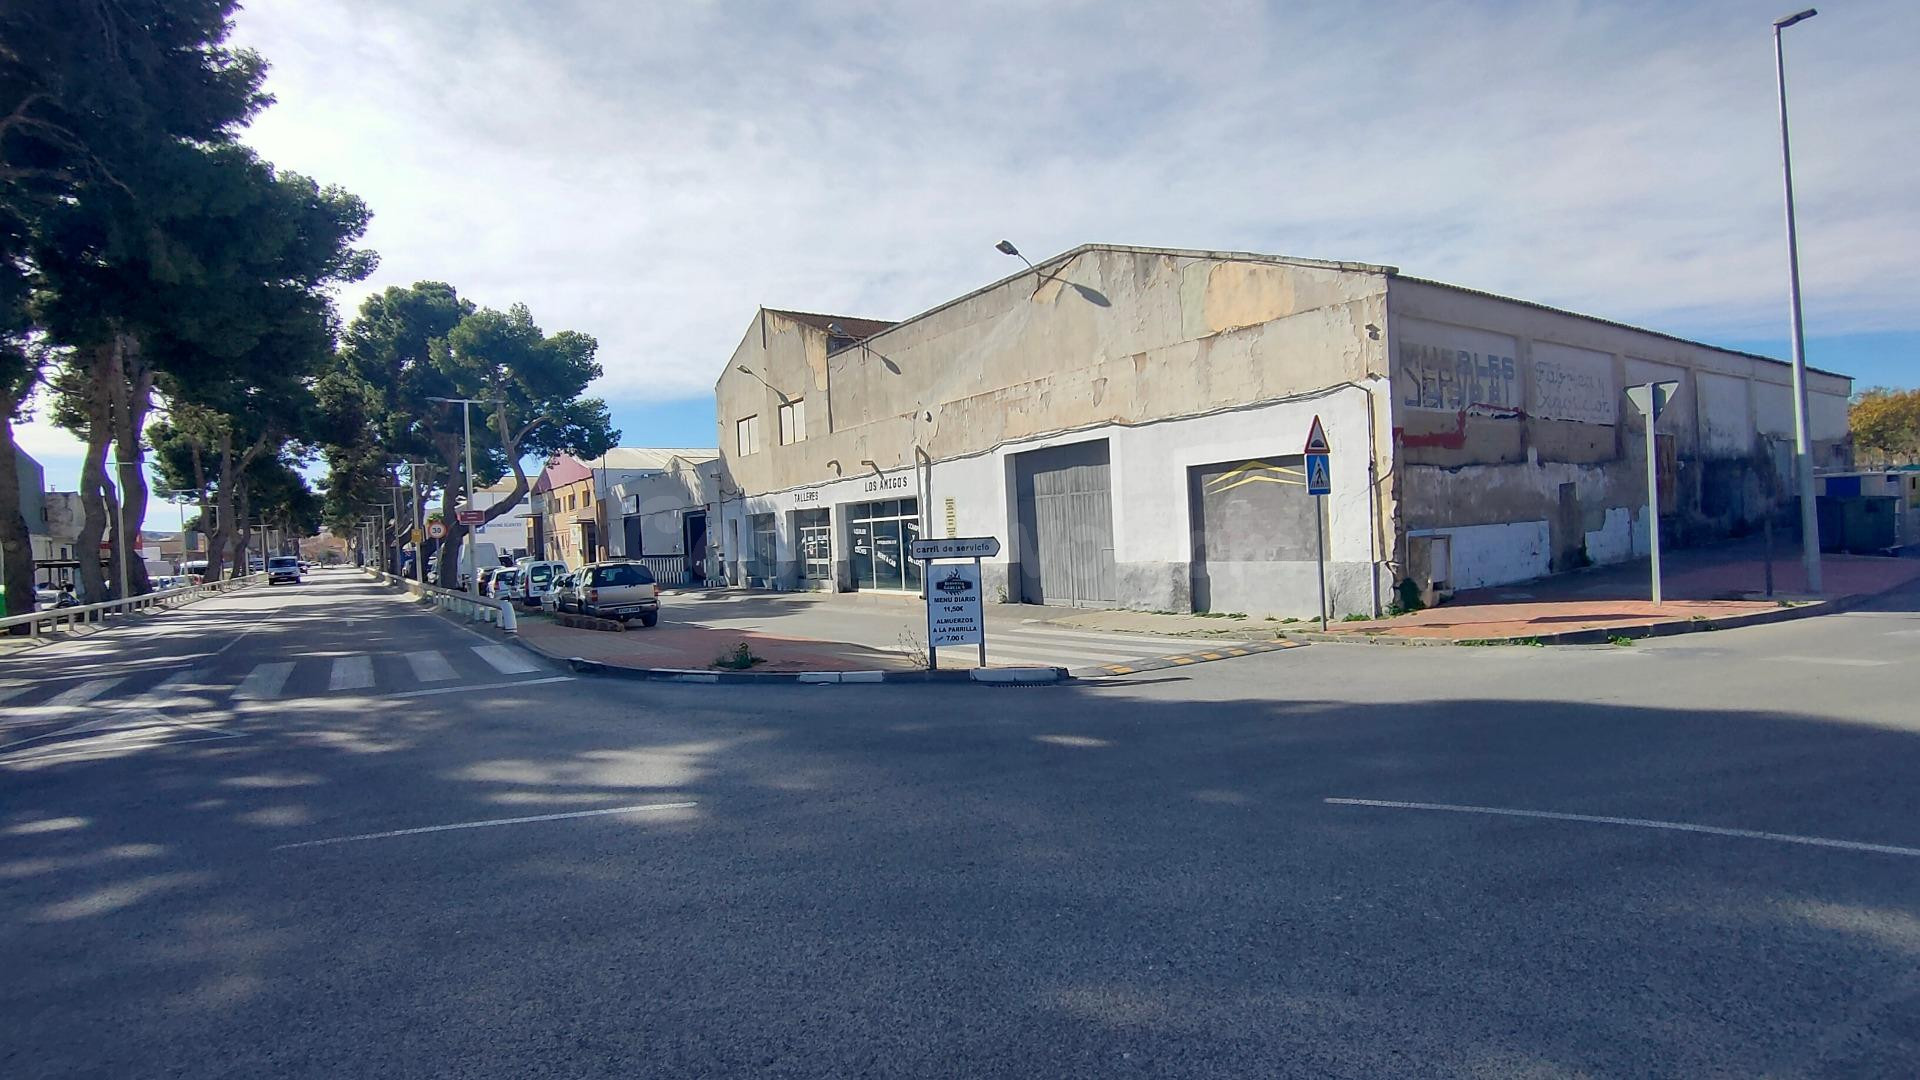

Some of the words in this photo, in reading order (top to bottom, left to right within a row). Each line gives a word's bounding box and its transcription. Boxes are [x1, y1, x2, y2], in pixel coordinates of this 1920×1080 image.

[864, 481, 877, 492] LOS
[879, 476, 908, 491] AMIGOS
[794, 491, 819, 503] TALLERES
[916, 545, 939, 554] carril
[942, 543, 953, 552] de
[956, 542, 990, 552] servicio
